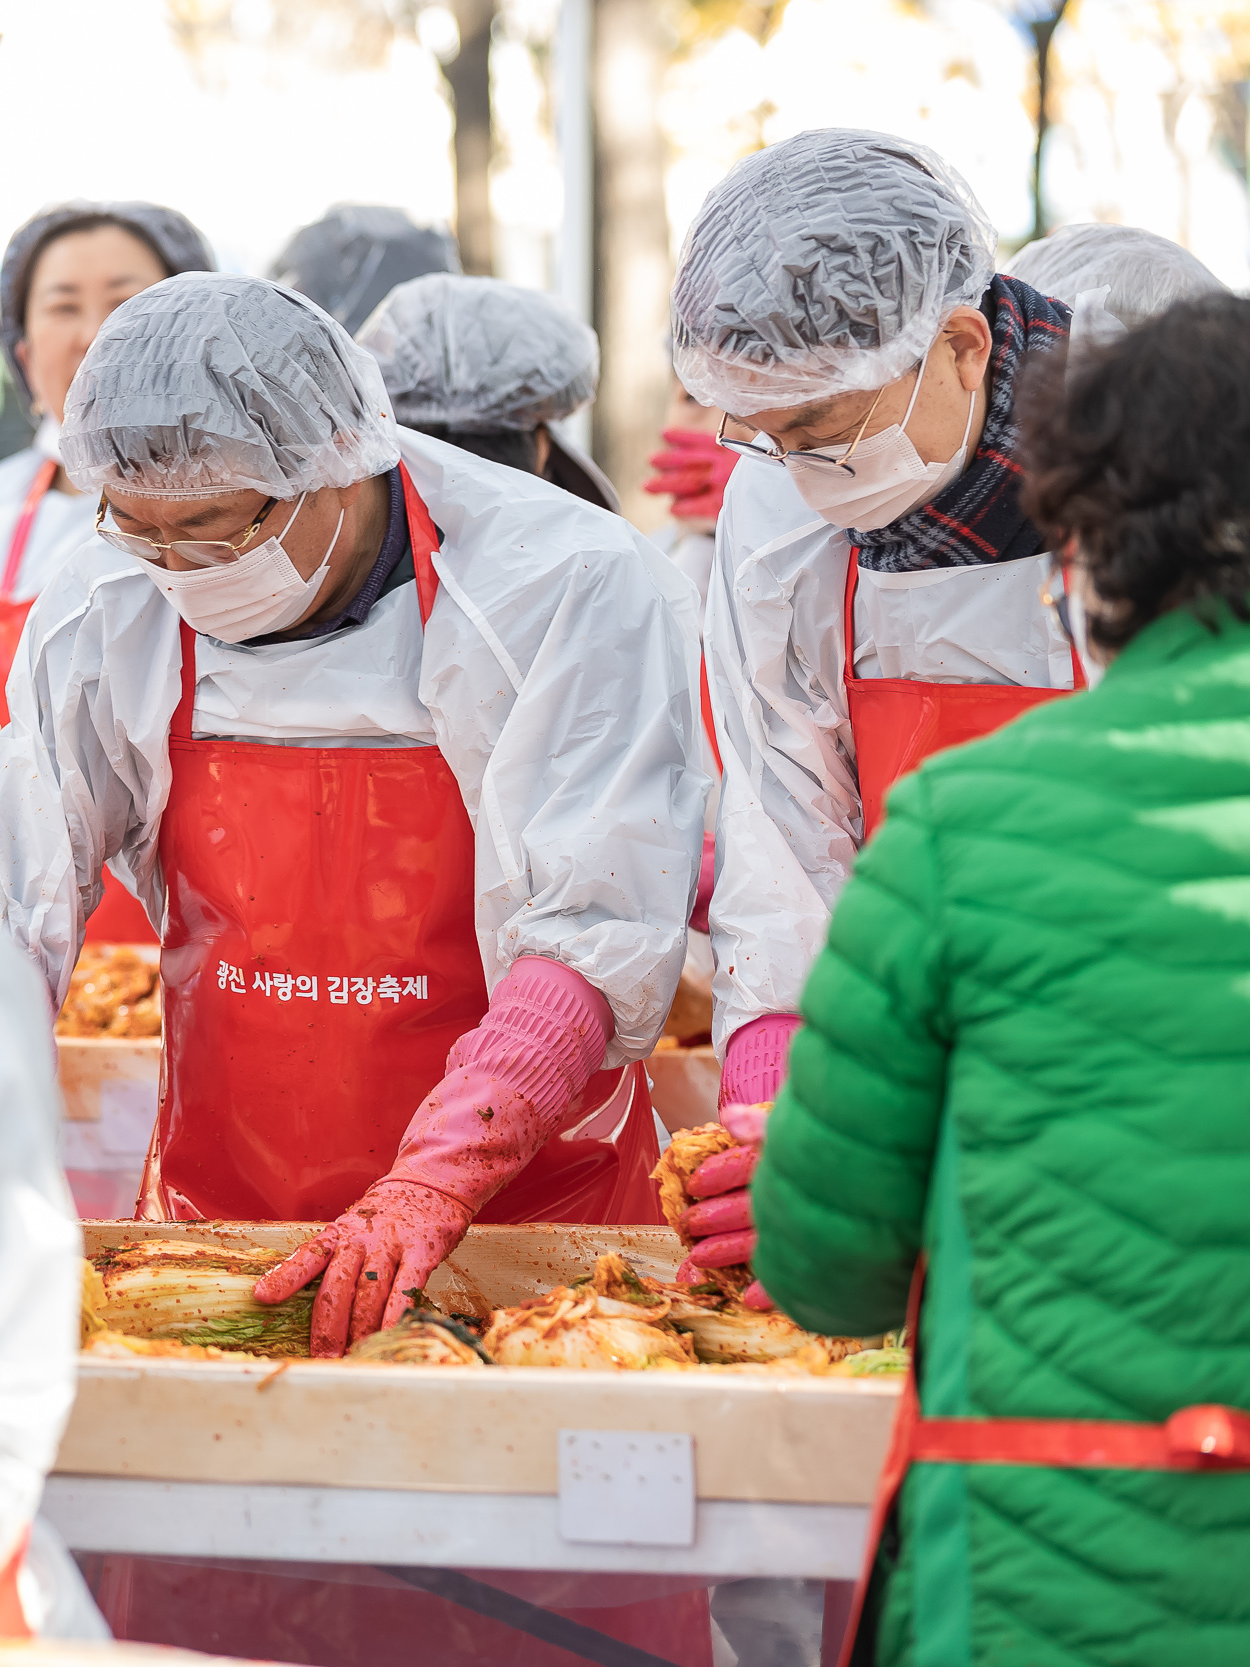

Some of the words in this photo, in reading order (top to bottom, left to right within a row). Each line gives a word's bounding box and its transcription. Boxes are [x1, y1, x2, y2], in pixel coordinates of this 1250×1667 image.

[216, 959, 247, 994] 광진
[251, 971, 319, 1001] 사랑의
[326, 974, 429, 1005] 김장축제
